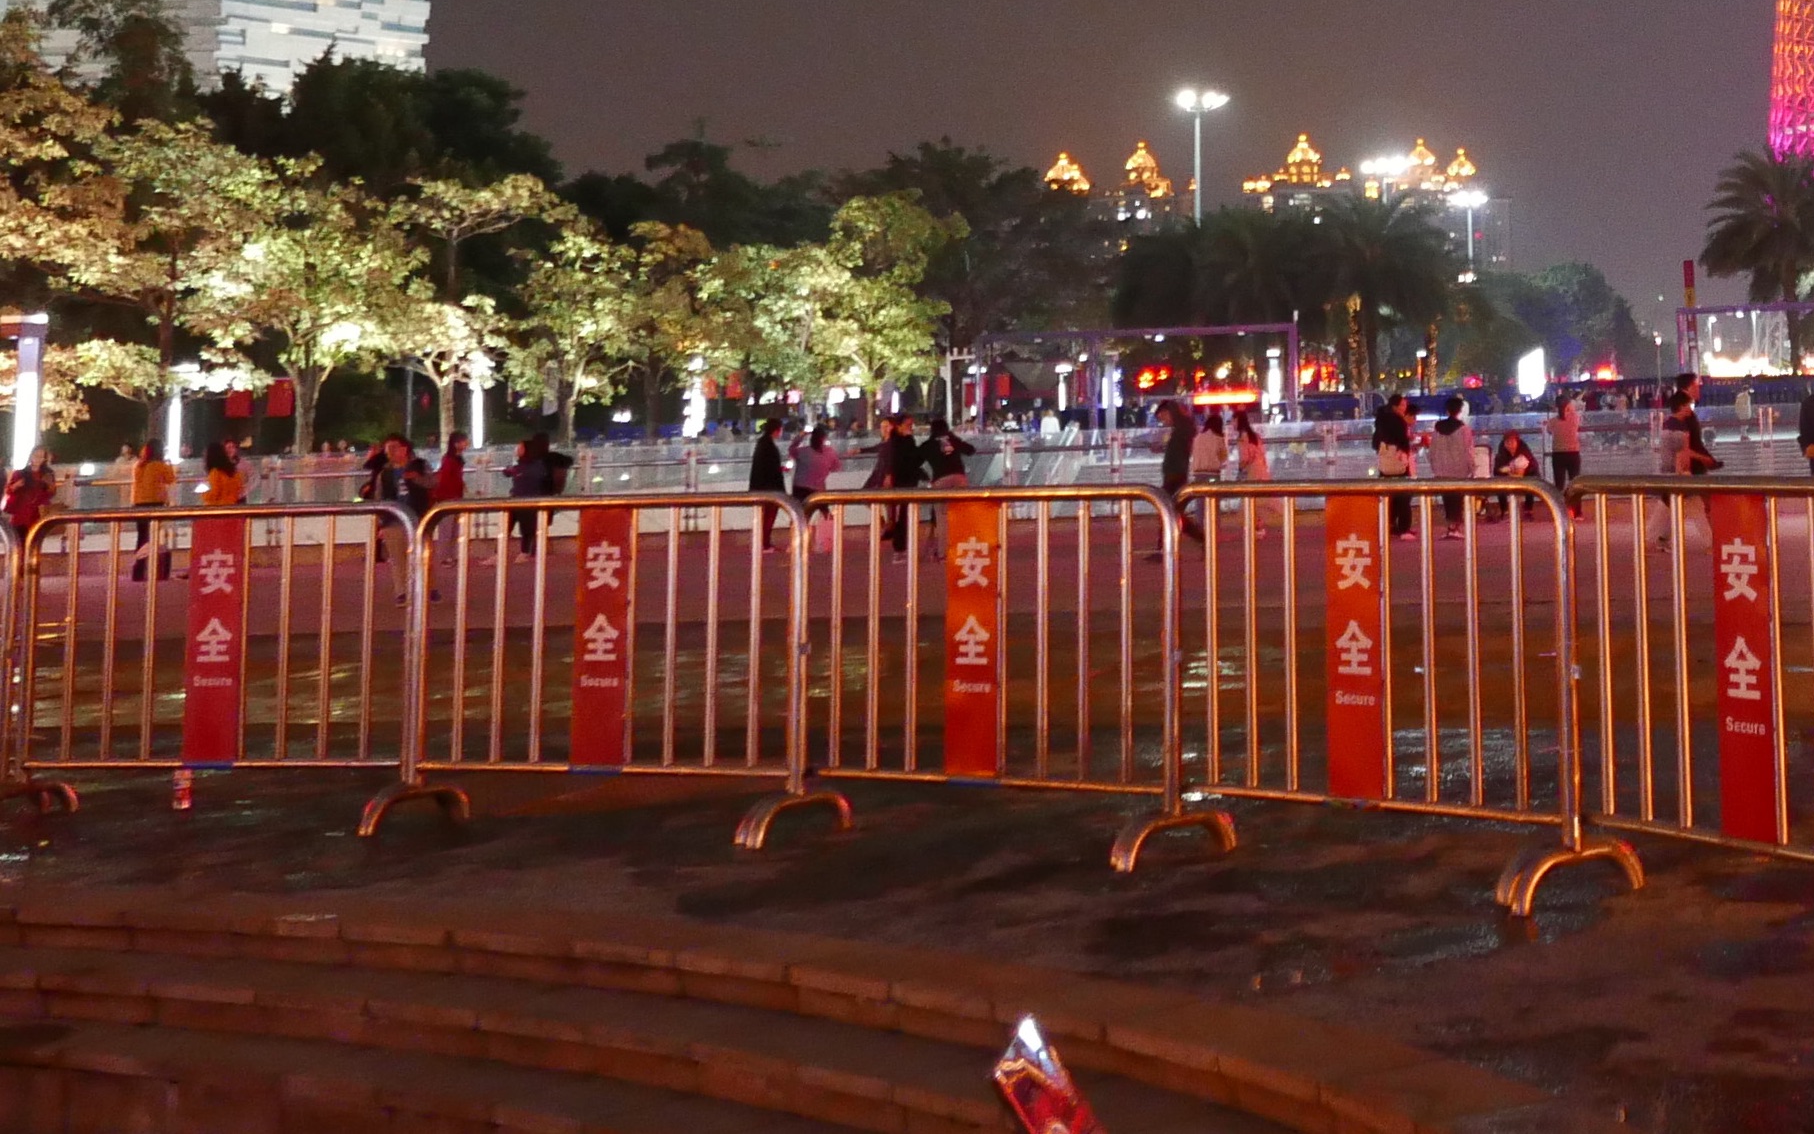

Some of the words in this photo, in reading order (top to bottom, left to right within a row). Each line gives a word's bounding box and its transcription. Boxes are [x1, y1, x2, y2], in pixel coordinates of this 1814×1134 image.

[195, 548, 235, 663] 安全
[582, 540, 622, 662] 安全
[954, 536, 992, 665] 安全
[1335, 533, 1373, 676] 安全
[1720, 537, 1762, 701] 安全
[1335, 689, 1376, 707] Secure
[1725, 715, 1766, 736] Secure
